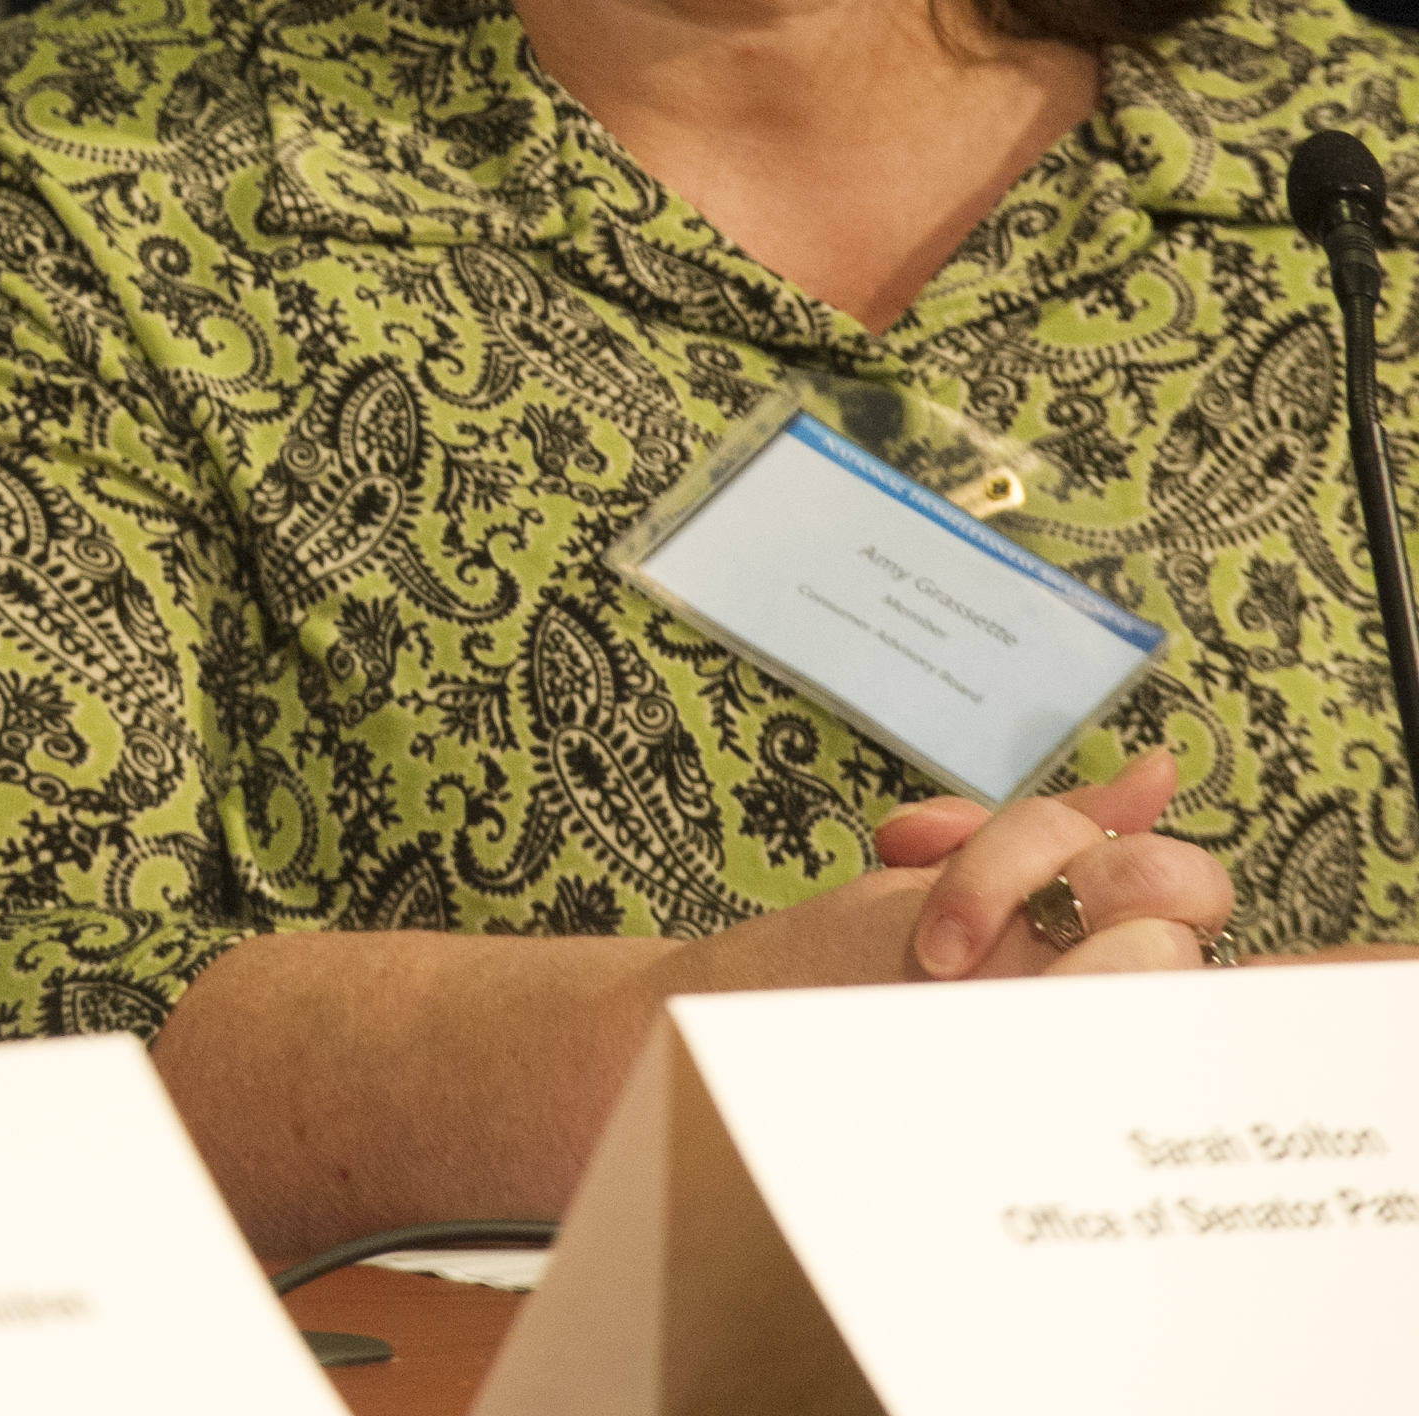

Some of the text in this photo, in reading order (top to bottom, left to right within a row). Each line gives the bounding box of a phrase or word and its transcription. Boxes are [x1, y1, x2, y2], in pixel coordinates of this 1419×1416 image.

[858, 545, 911, 581] Amy
[915, 576, 1018, 646] Grassette
[1127, 1120, 1389, 1169] Sarah Bolton
[1001, 1201, 1125, 1246] Office
[1131, 1194, 1173, 1240] of
[1175, 1194, 1332, 1237] Senator
